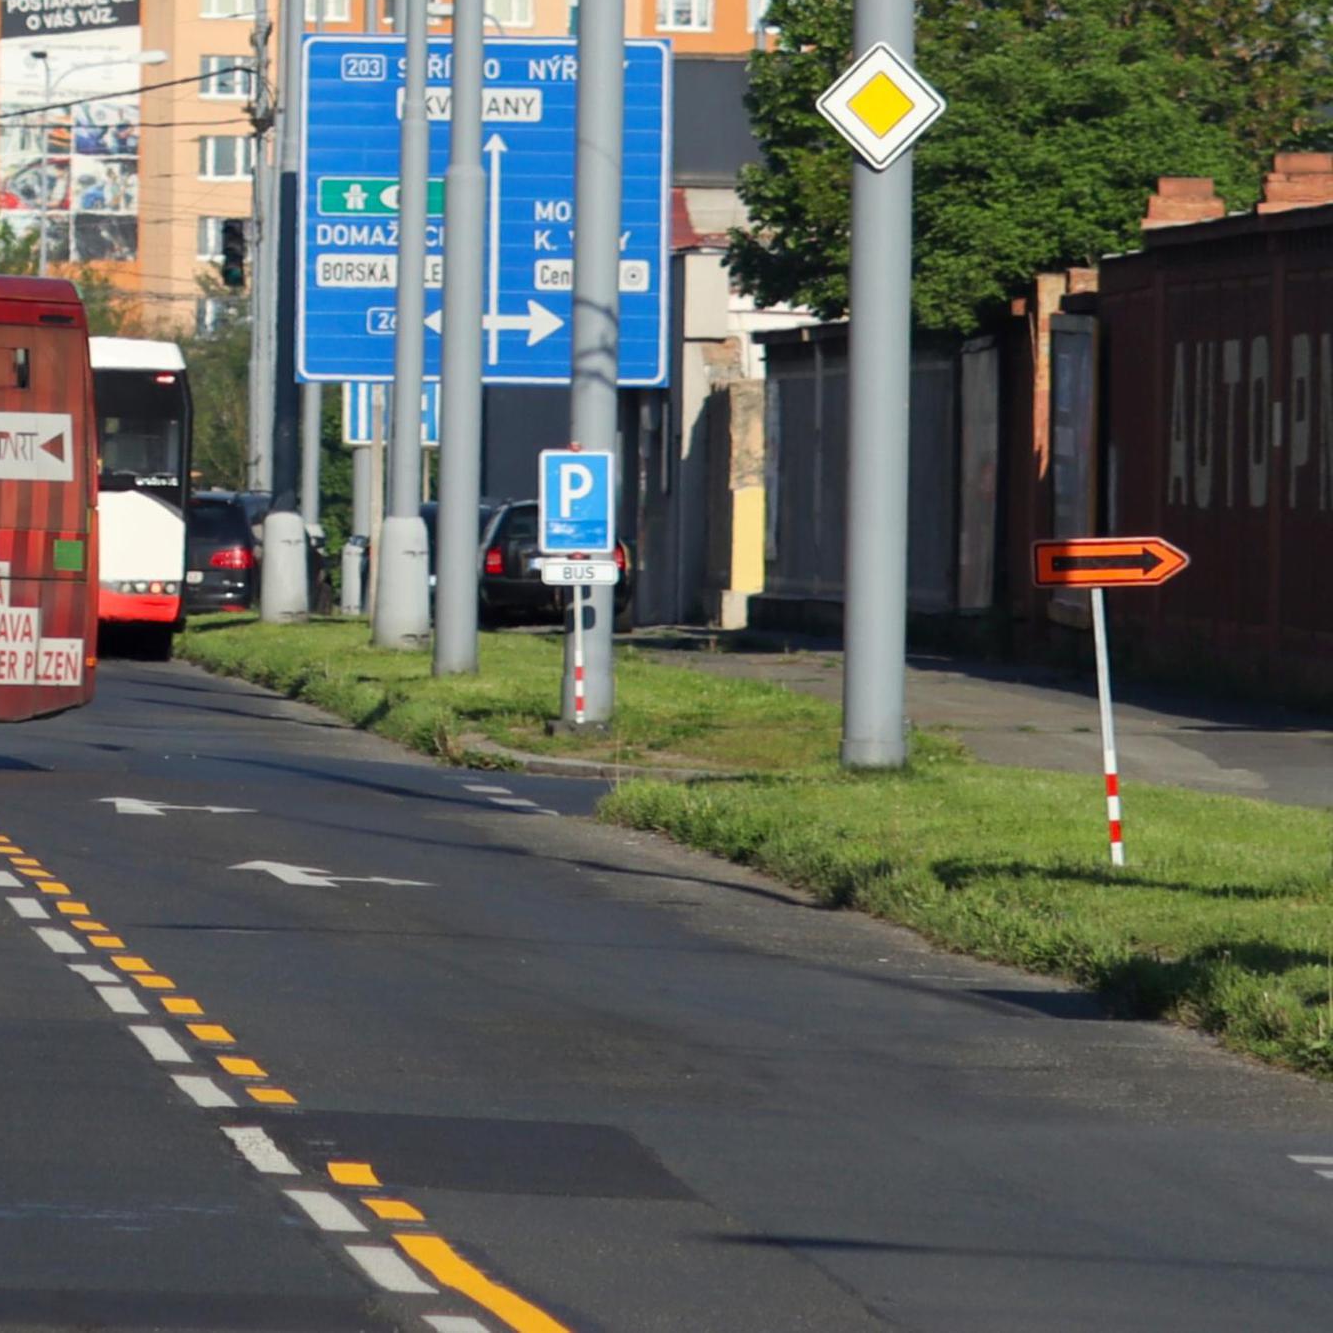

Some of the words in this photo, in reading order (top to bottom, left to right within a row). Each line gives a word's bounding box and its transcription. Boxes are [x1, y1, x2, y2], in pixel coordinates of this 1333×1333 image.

[26, 16, 42, 30] O
[44, 9, 78, 29] VÁŠ
[346, 60, 381, 76] 203
[322, 257, 391, 282] BORSKÁ
[560, 463, 593, 518] P
[563, 566, 595, 579] BUS
[23, 644, 79, 681] PLZEŇ
